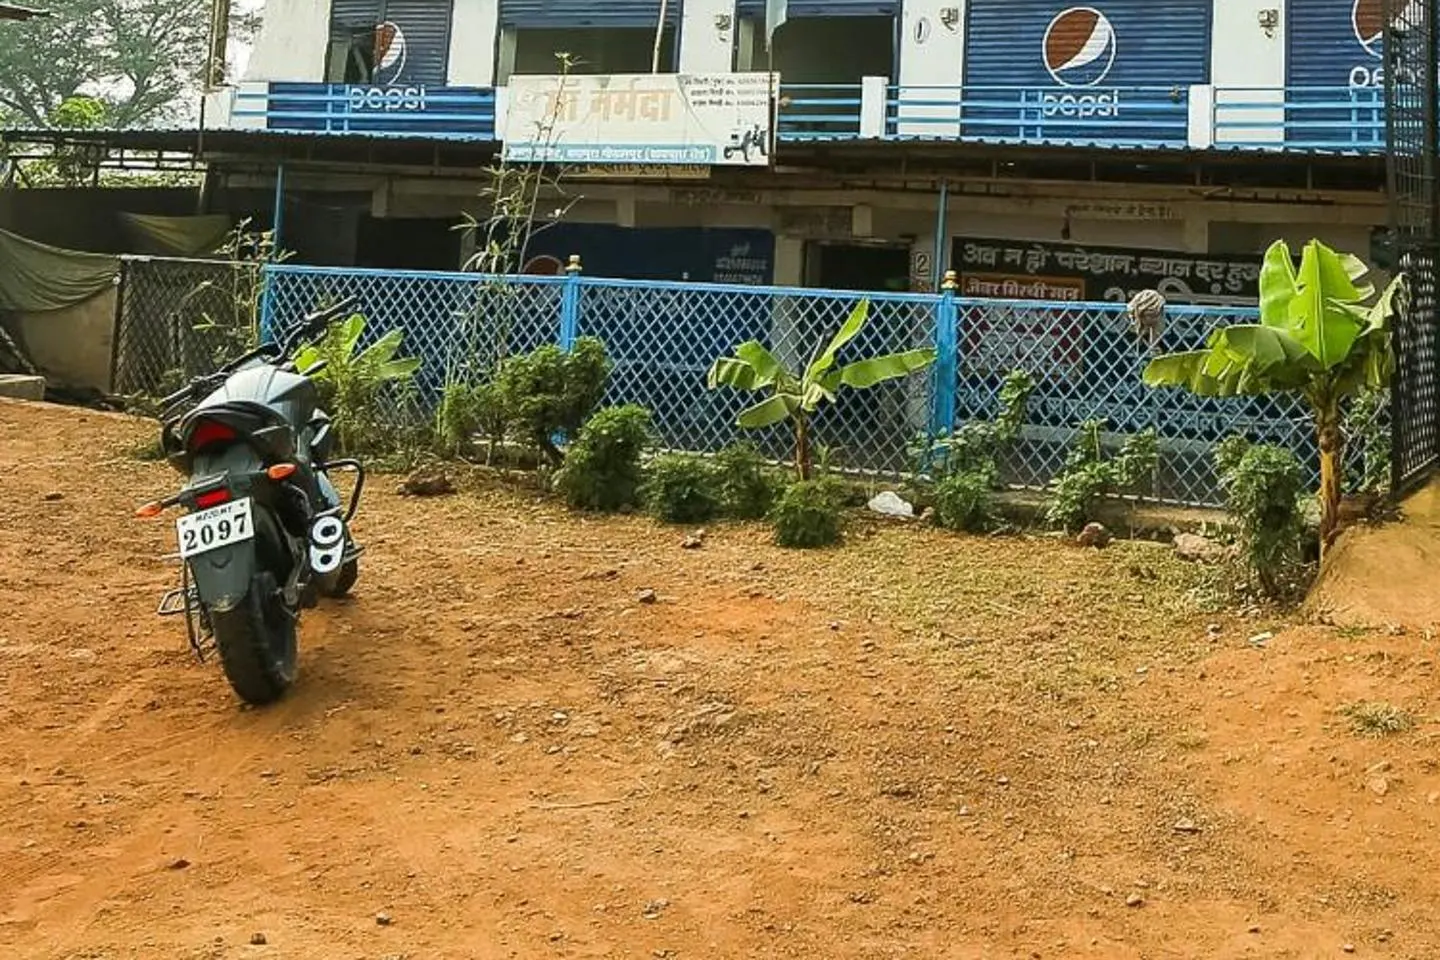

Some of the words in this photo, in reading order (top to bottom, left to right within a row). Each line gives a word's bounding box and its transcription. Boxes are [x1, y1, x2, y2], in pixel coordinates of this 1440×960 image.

[350, 84, 426, 113] pepsi
[1043, 89, 1119, 119] pepsi
[1004, 248, 1023, 265] न
[183, 512, 247, 552] 2097
